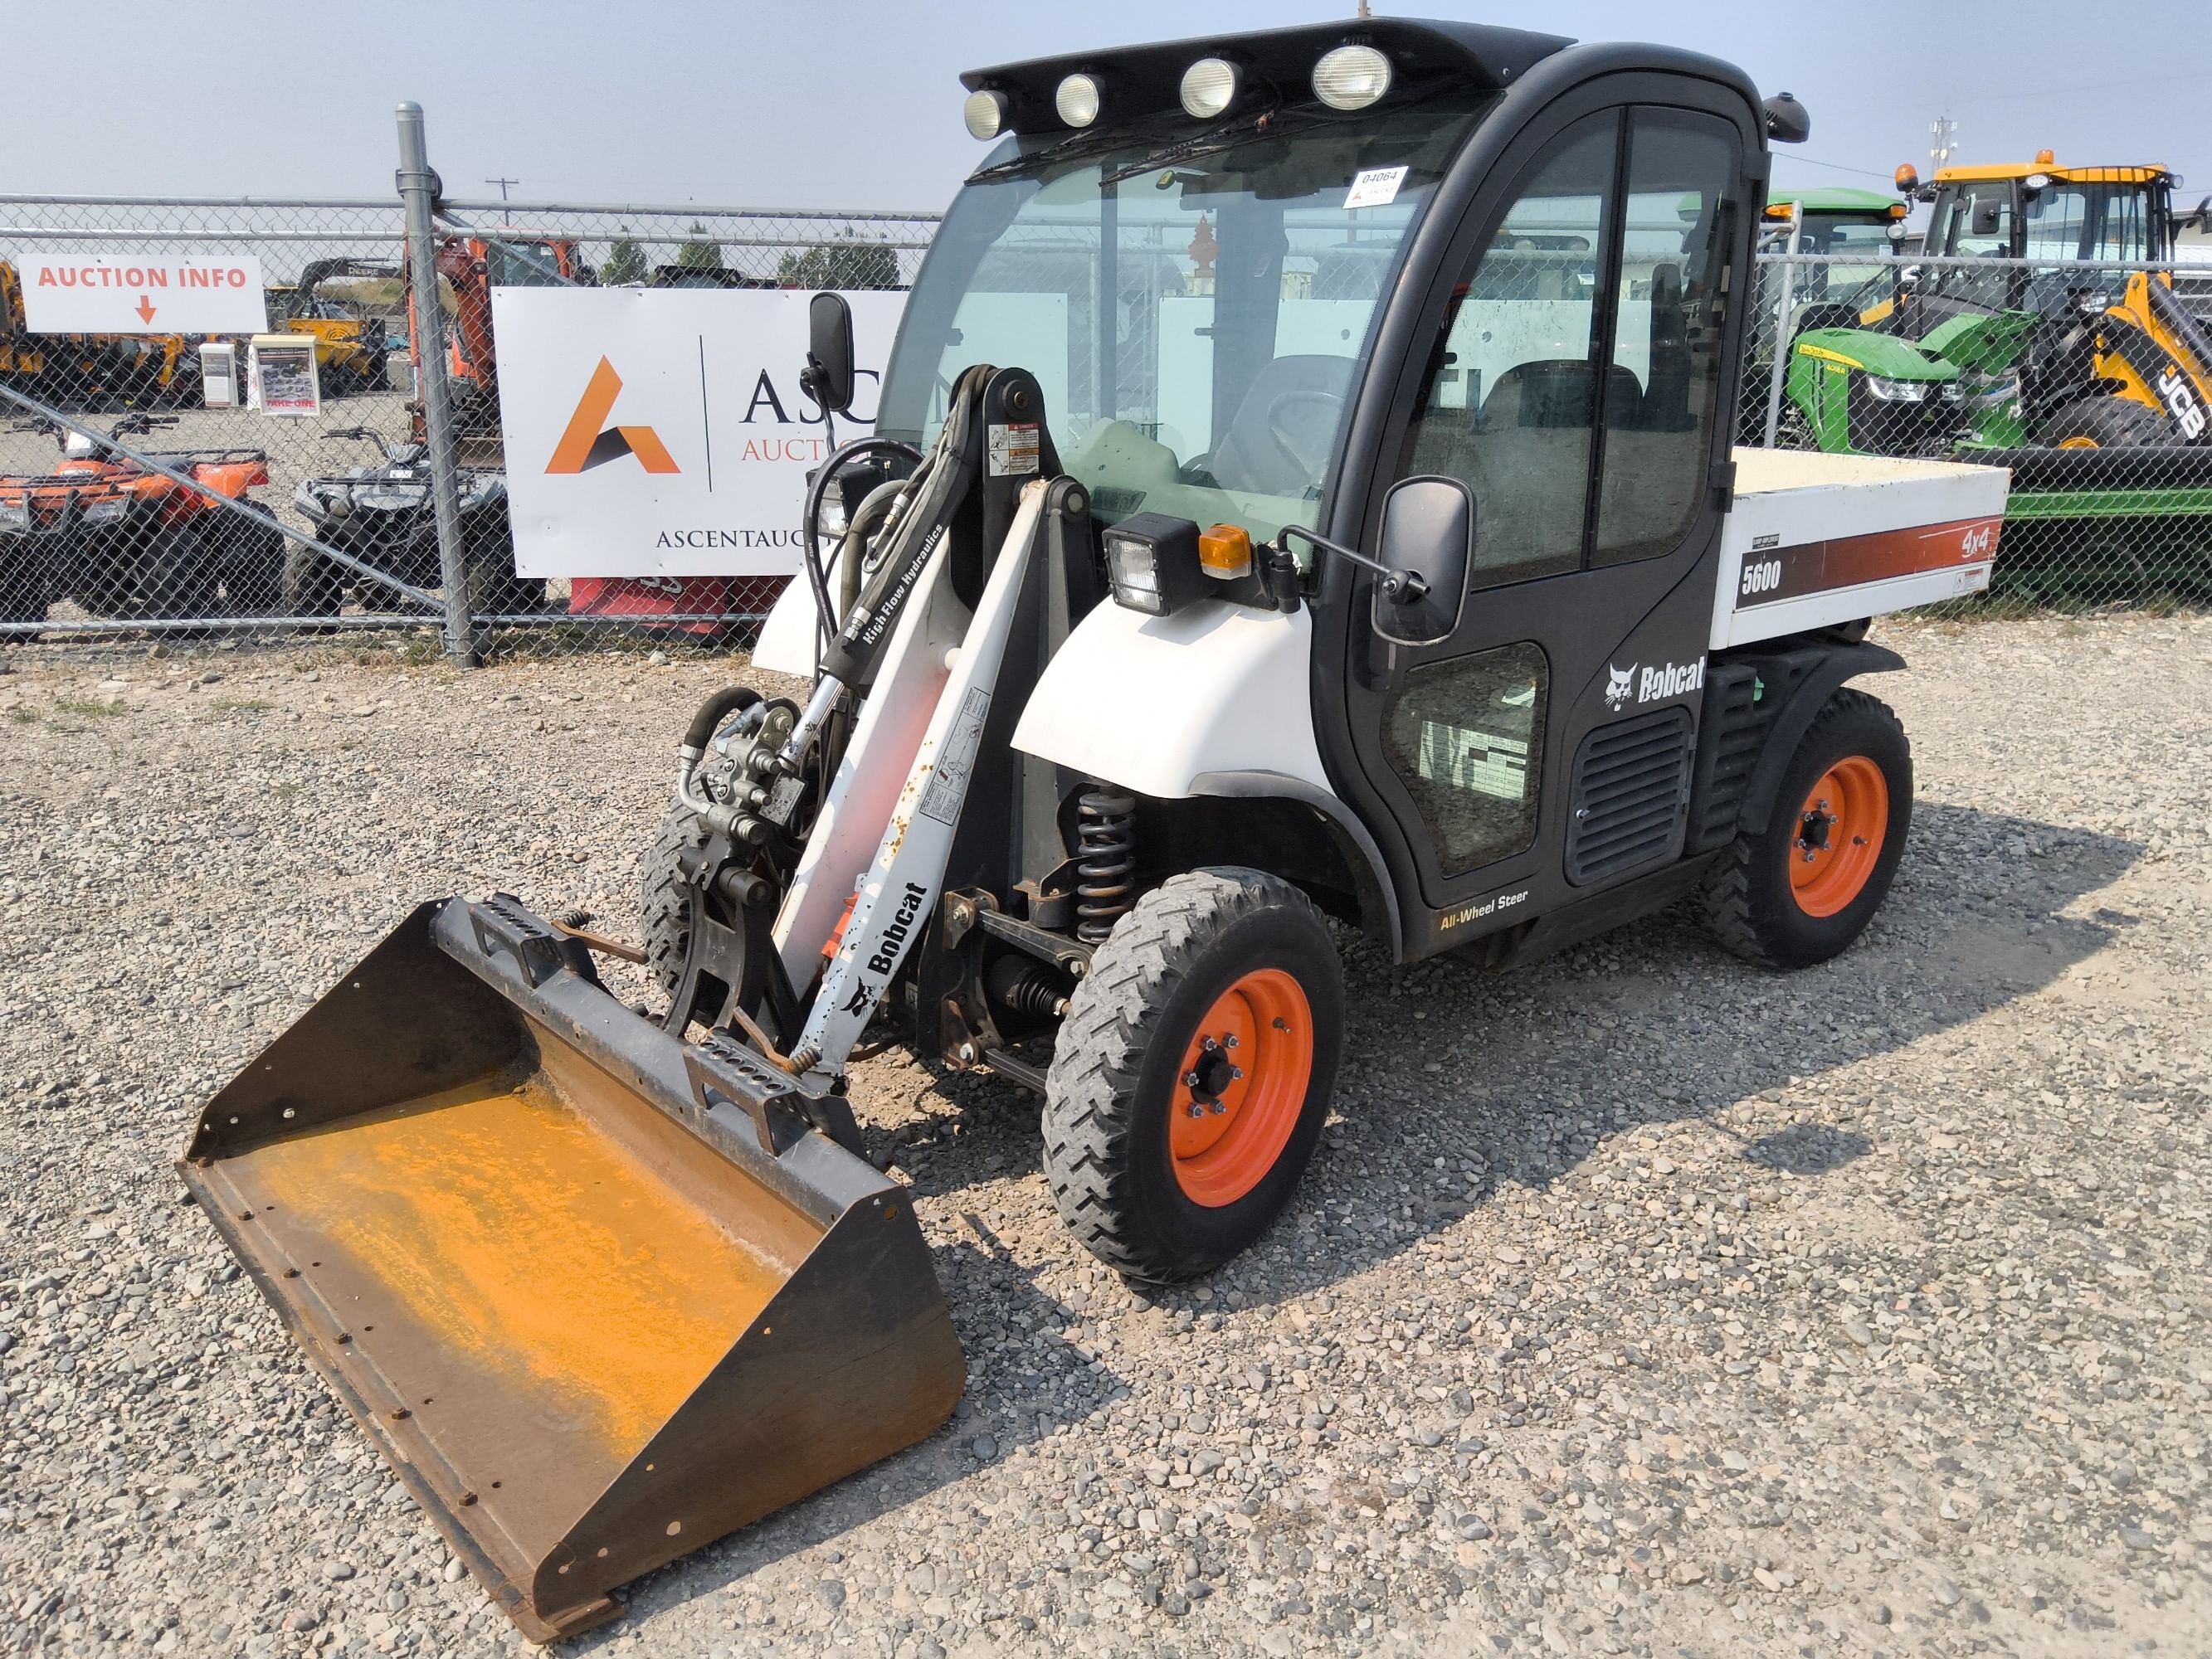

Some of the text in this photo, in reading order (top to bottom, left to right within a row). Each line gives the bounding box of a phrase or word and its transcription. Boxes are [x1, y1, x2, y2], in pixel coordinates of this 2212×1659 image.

[1362, 171, 1398, 183] 04064
[38, 267, 246, 288] AUCTION INFO
[348, 266, 379, 275] DEERE
[2158, 374, 2205, 440] JCB
[741, 439, 860, 461] AUCT
[656, 530, 831, 548] ASCENTAUC
[1961, 527, 1990, 554] 4x4
[862, 523, 943, 645] High Flow Hydraulics
[1742, 560, 1781, 595] 5600
[1638, 655, 1705, 703] Bobcat
[1440, 890, 1528, 931] All-Wheel Steer
[867, 882, 928, 975] Bobcat
